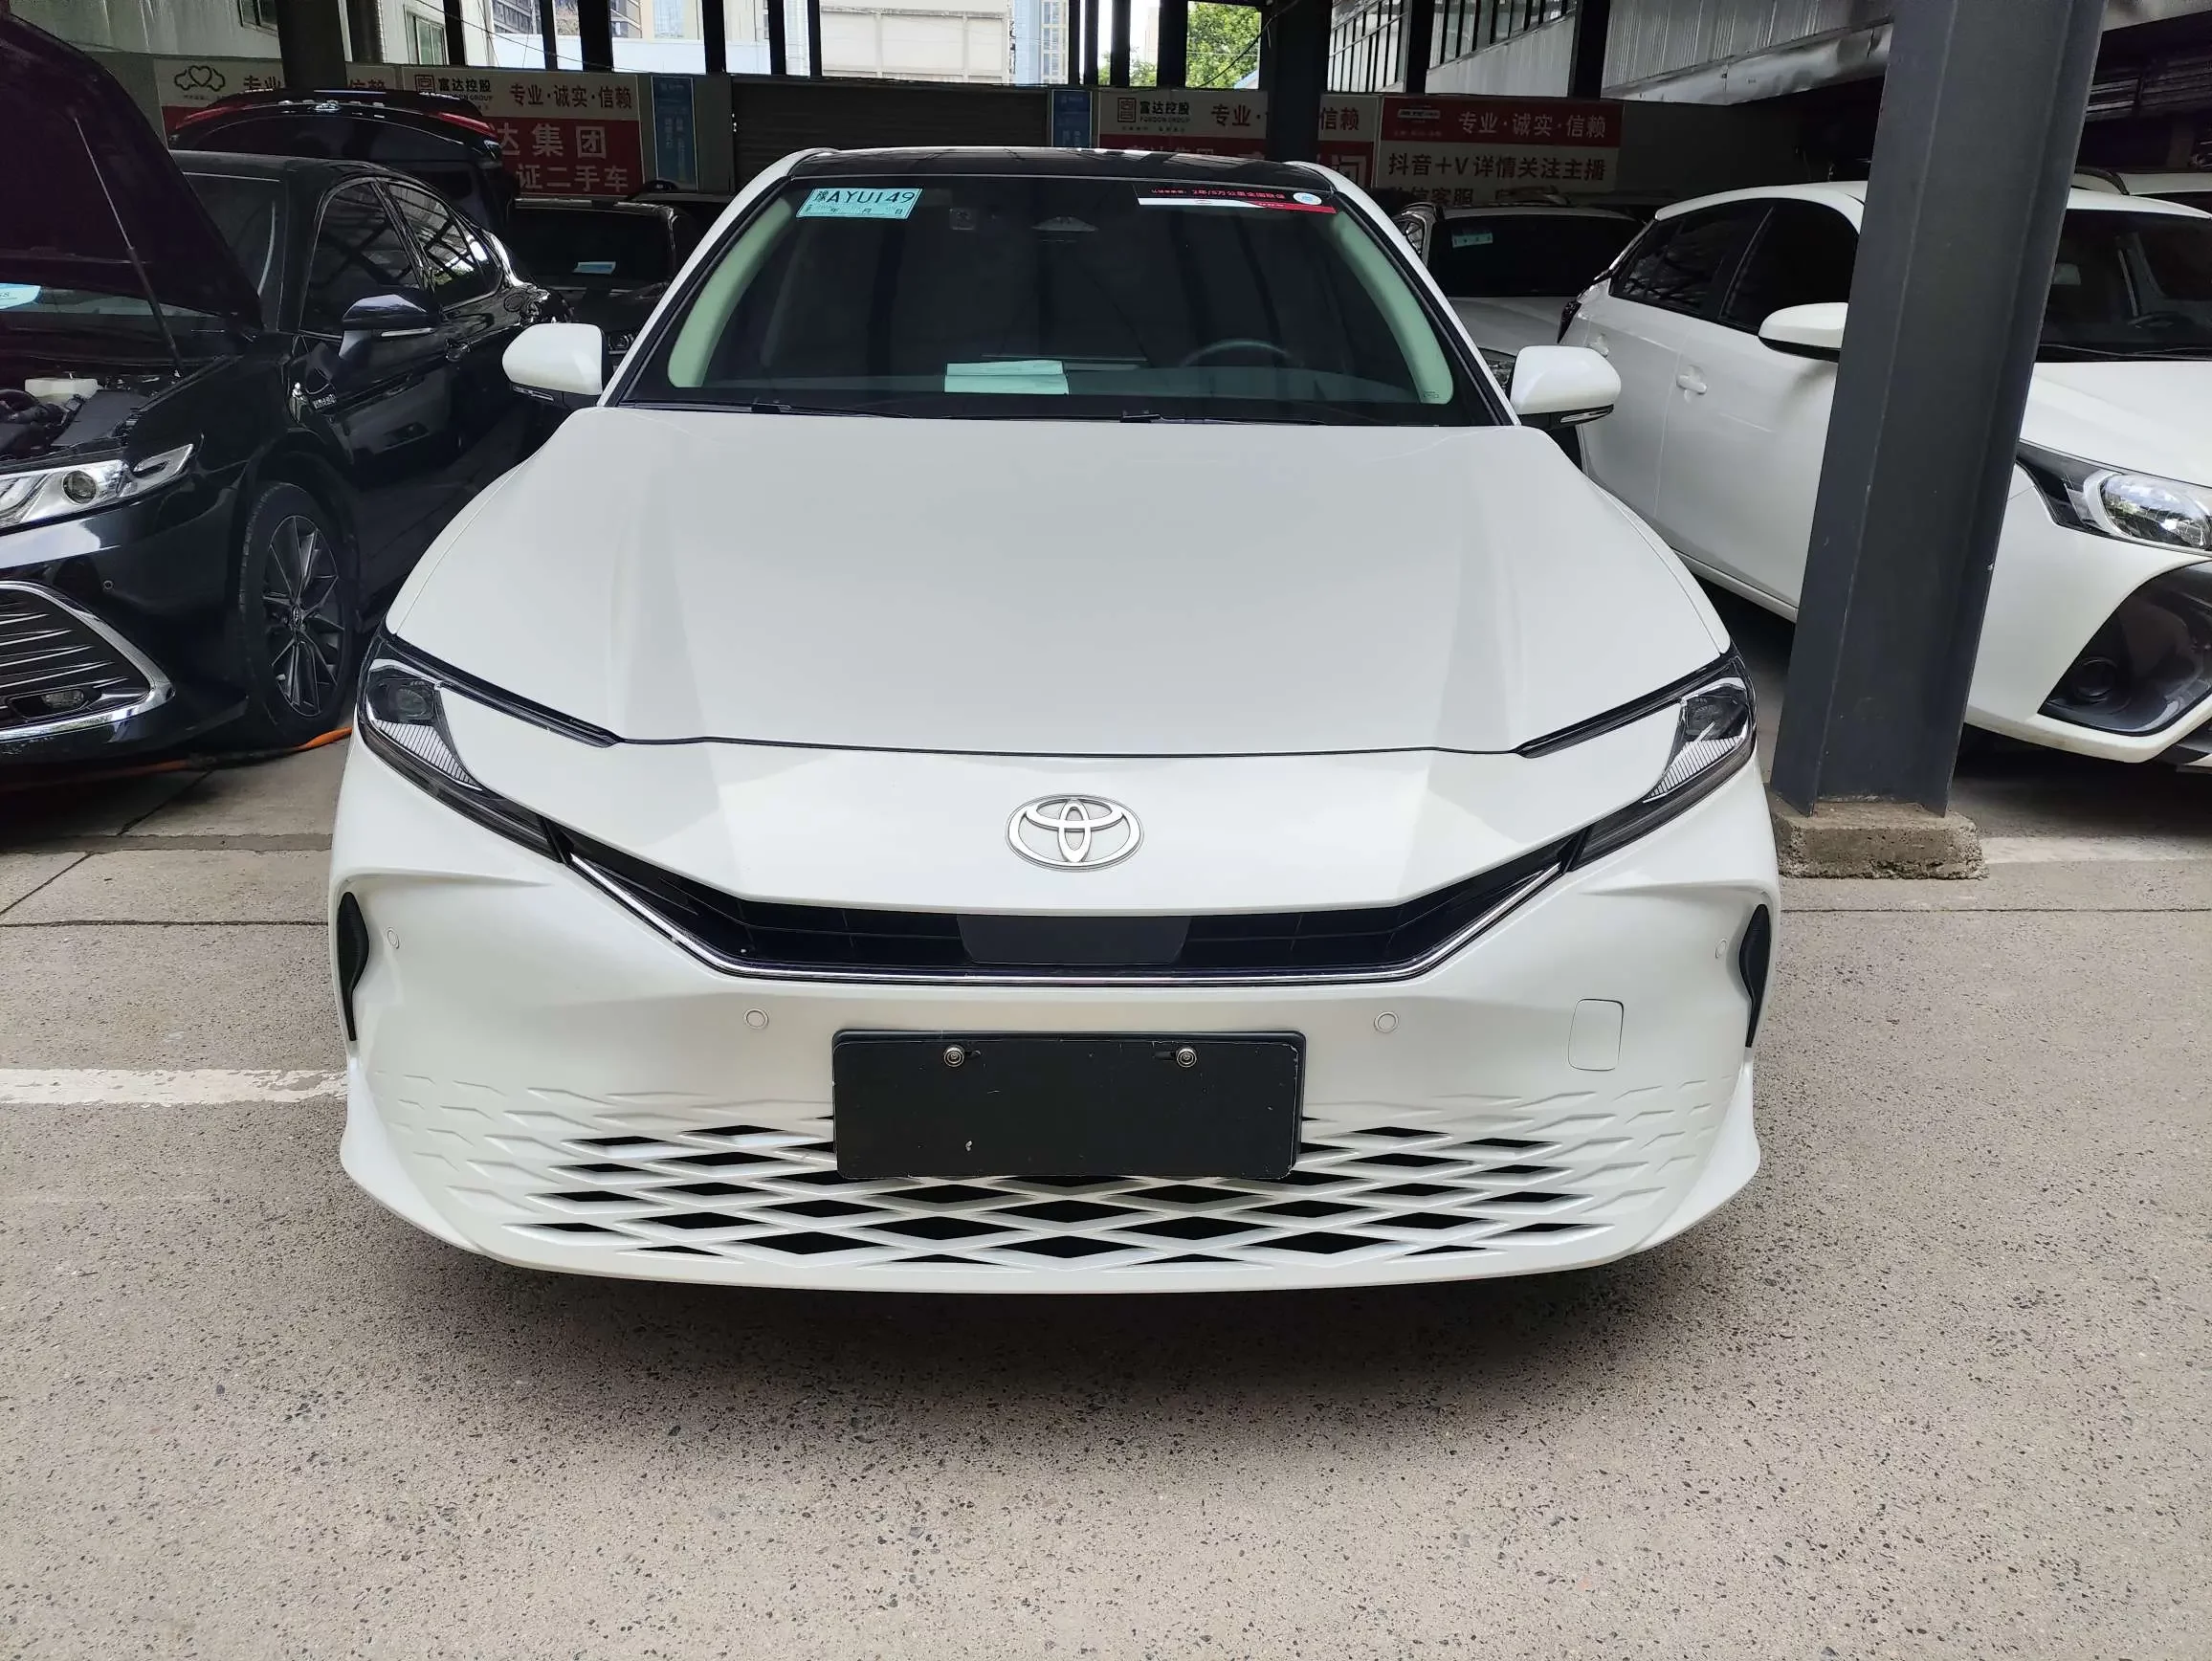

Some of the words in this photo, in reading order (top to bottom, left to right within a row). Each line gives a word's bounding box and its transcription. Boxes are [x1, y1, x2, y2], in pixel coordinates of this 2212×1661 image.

[438, 78, 492, 93] 富达控股
[1139, 100, 1190, 115] 富达控股
